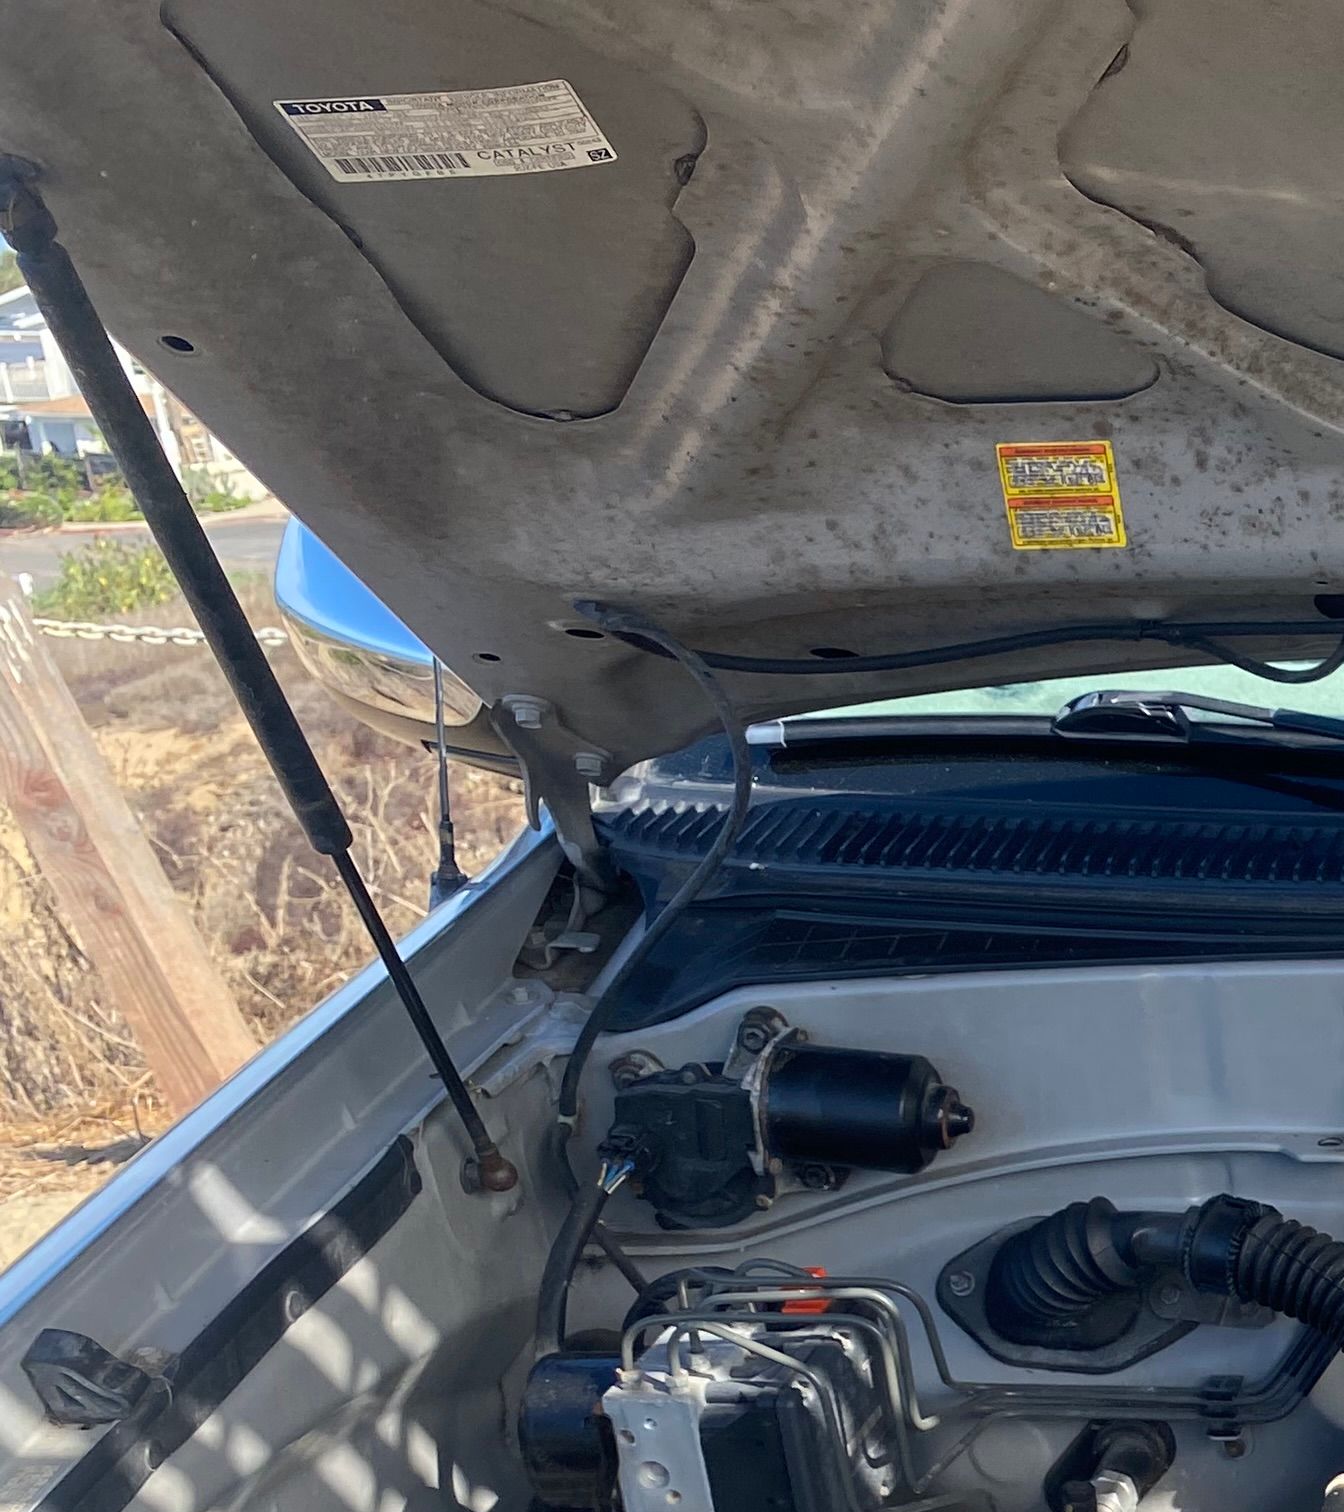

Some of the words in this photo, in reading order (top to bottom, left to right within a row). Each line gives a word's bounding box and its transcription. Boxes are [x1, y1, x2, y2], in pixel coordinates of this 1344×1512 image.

[293, 100, 375, 113] TOYOTA
[477, 142, 577, 161] CATALYST
[590, 149, 611, 161] SZ
